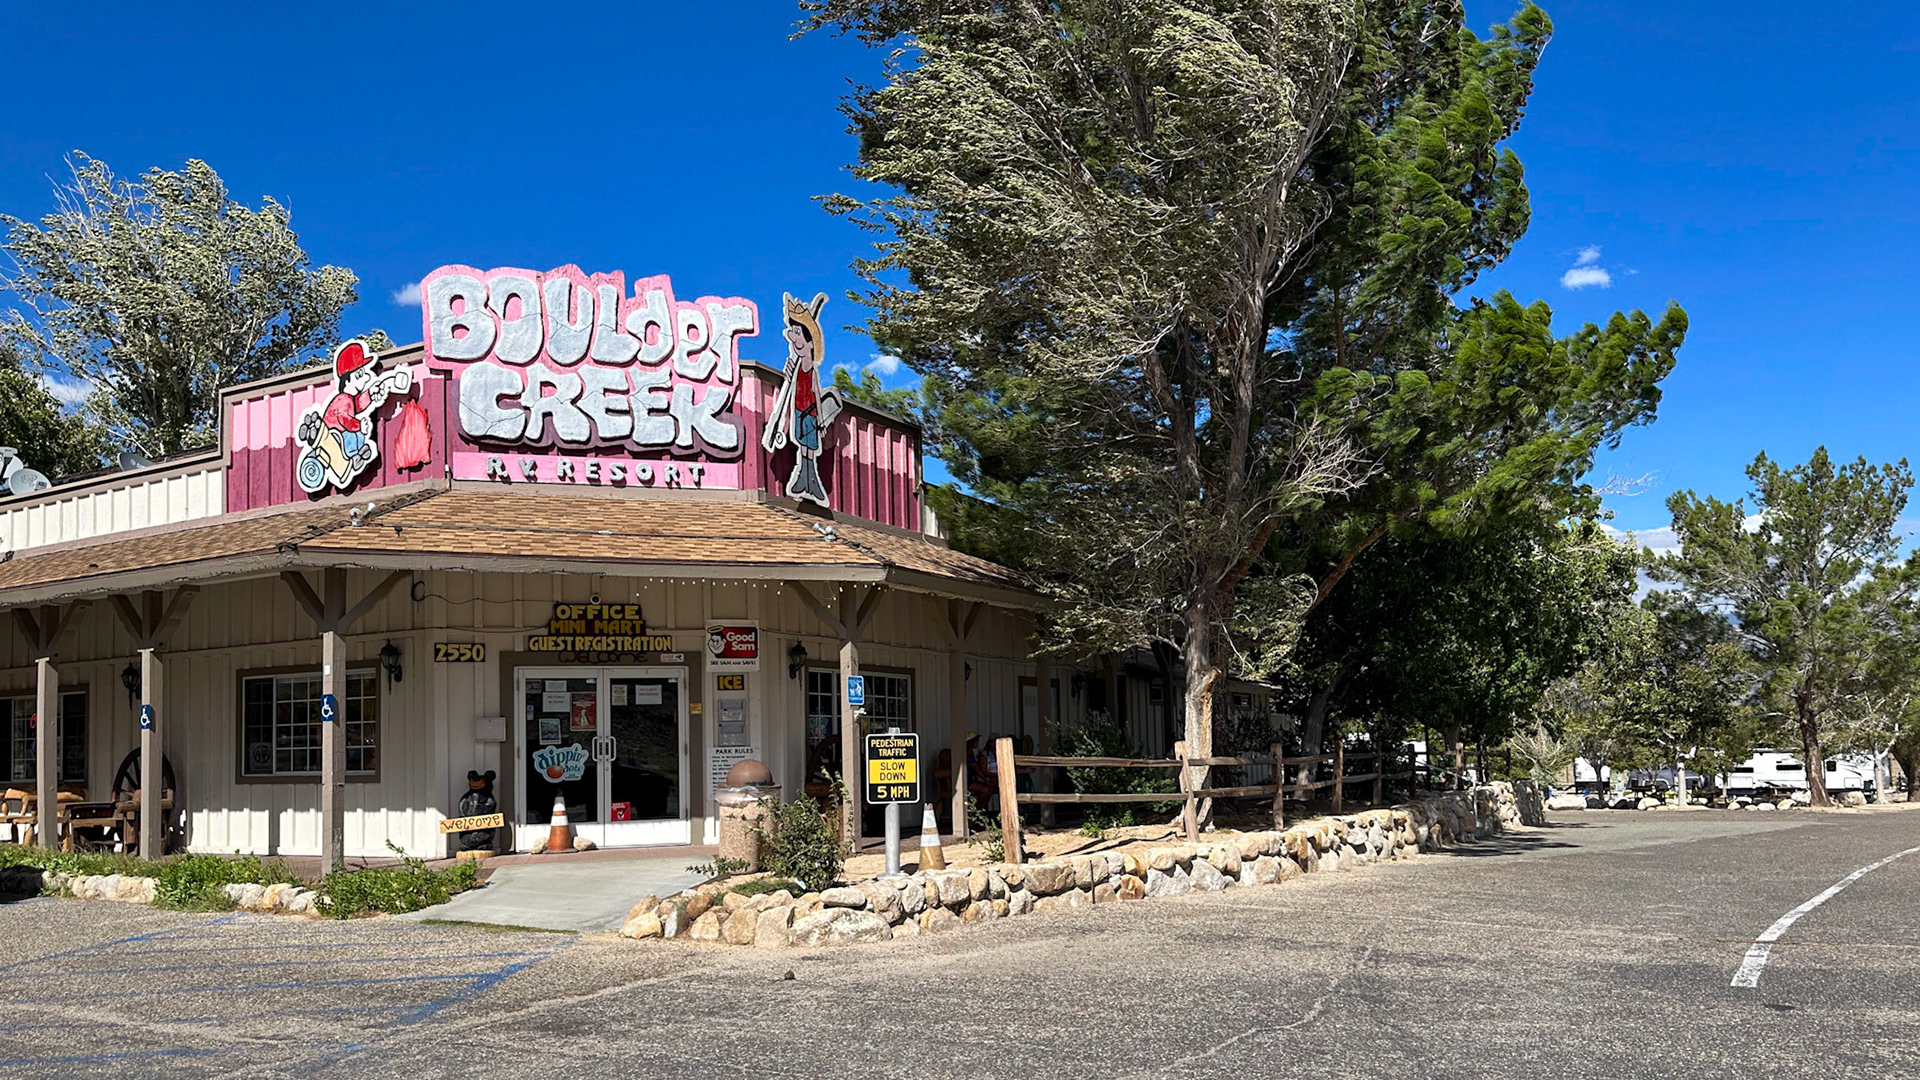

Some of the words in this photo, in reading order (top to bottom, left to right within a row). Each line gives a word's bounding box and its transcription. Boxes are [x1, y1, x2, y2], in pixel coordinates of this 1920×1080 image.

[459, 361, 739, 450] CREEK
[557, 458, 705, 483] RESORT
[556, 605, 639, 620] OFFICE
[550, 620, 586, 634] MINI
[595, 620, 644, 635] MART
[529, 636, 574, 651] GUEST
[574, 635, 672, 651] REGISTRATION
[726, 632, 756, 642] Good
[435, 643, 485, 662] 2550
[731, 641, 755, 651] Sam
[719, 675, 743, 690] ICE
[870, 738, 914, 748] PEDESTRIAN
[878, 748, 907, 757] TRAFFIC
[880, 762, 906, 771] SLOW
[879, 772, 906, 781] DOWN
[877, 785, 888, 799] 5
[890, 785, 910, 799] MPH
